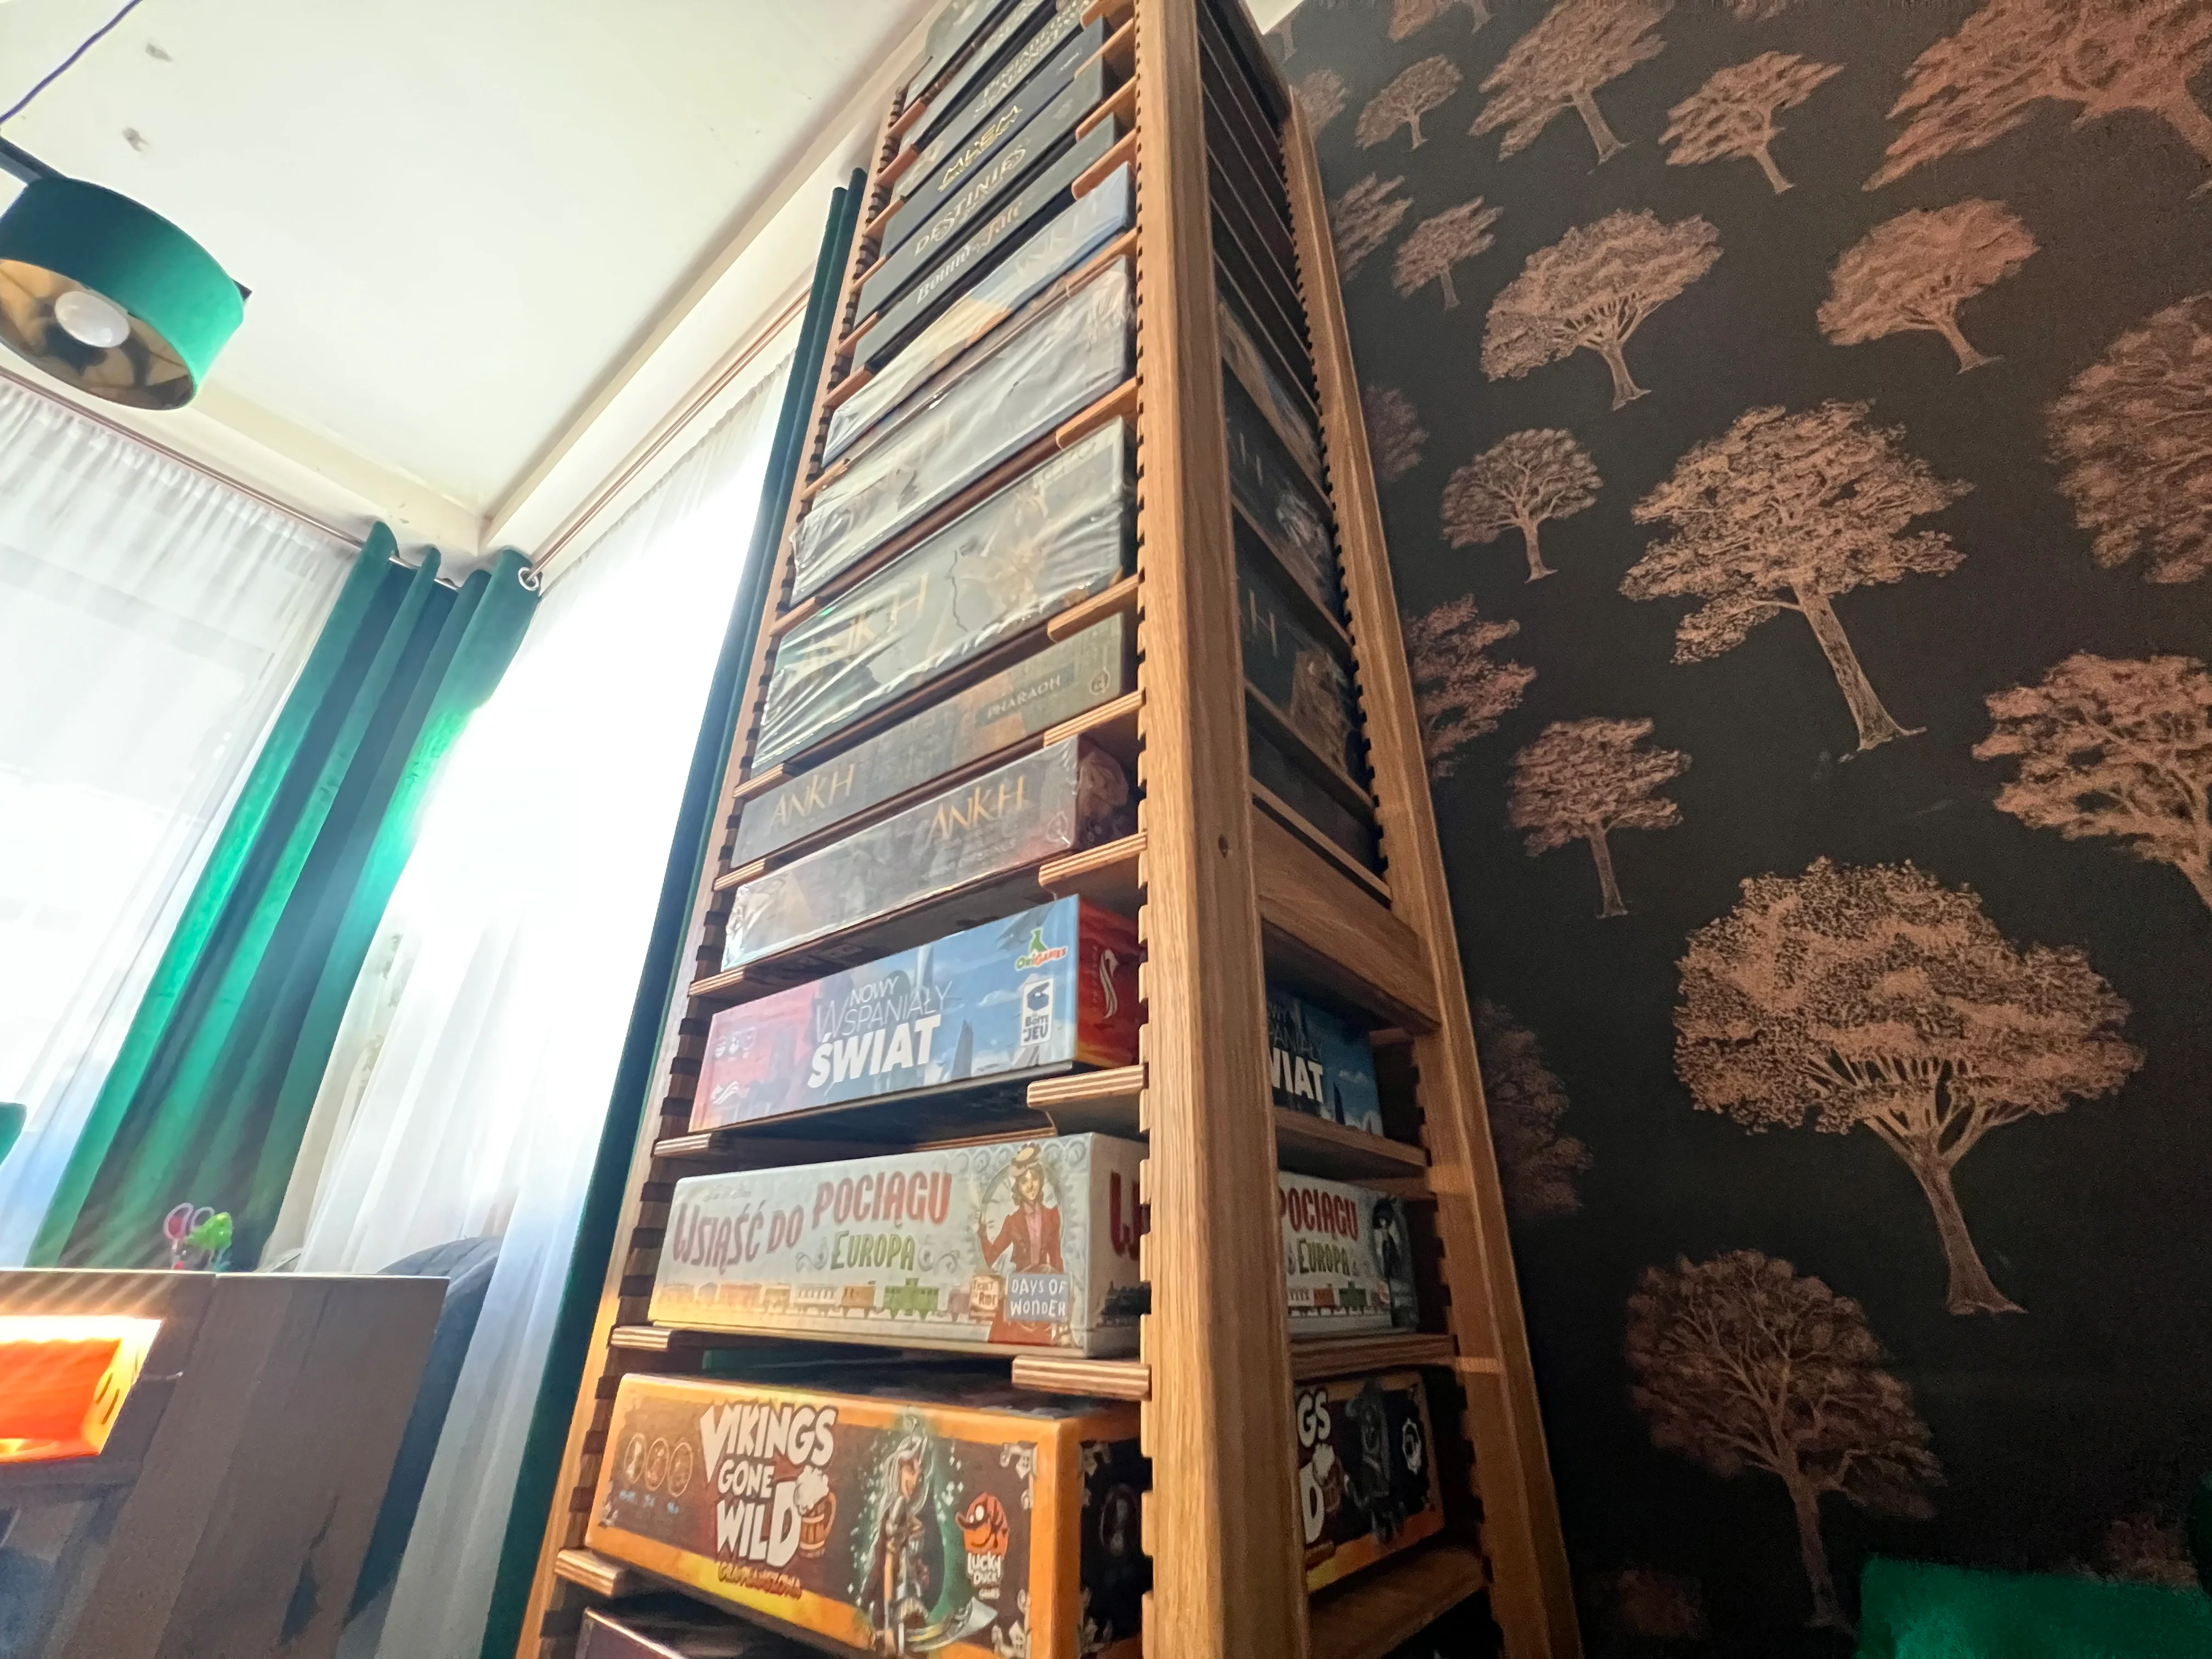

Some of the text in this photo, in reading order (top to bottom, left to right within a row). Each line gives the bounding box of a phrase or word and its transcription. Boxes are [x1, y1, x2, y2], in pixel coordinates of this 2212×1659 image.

[915, 144, 1026, 256] DESTINIES
[988, 674, 1061, 719] PHARAOH
[766, 763, 856, 835] ANKH
[924, 775, 1025, 848] ANKH
[816, 981, 952, 1042] WSPANIAŁY
[850, 976, 899, 1007] NOWY
[808, 1014, 941, 1088] ŚWIAT
[1023, 1022, 1048, 1042] JEU
[674, 1171, 952, 1276] WSIĄŚĆ DO POCIĄGU
[831, 1229, 915, 1271] EUROPA
[1010, 1299, 1066, 1317] WONDER
[1011, 1278, 1068, 1296] DAYS OF
[699, 1403, 837, 1483] VIKINGS
[717, 1459, 775, 1499] GONE
[716, 1481, 802, 1568] WILD
[967, 1551, 1001, 1578] LUCKY
[973, 1571, 998, 1585] DUCK
